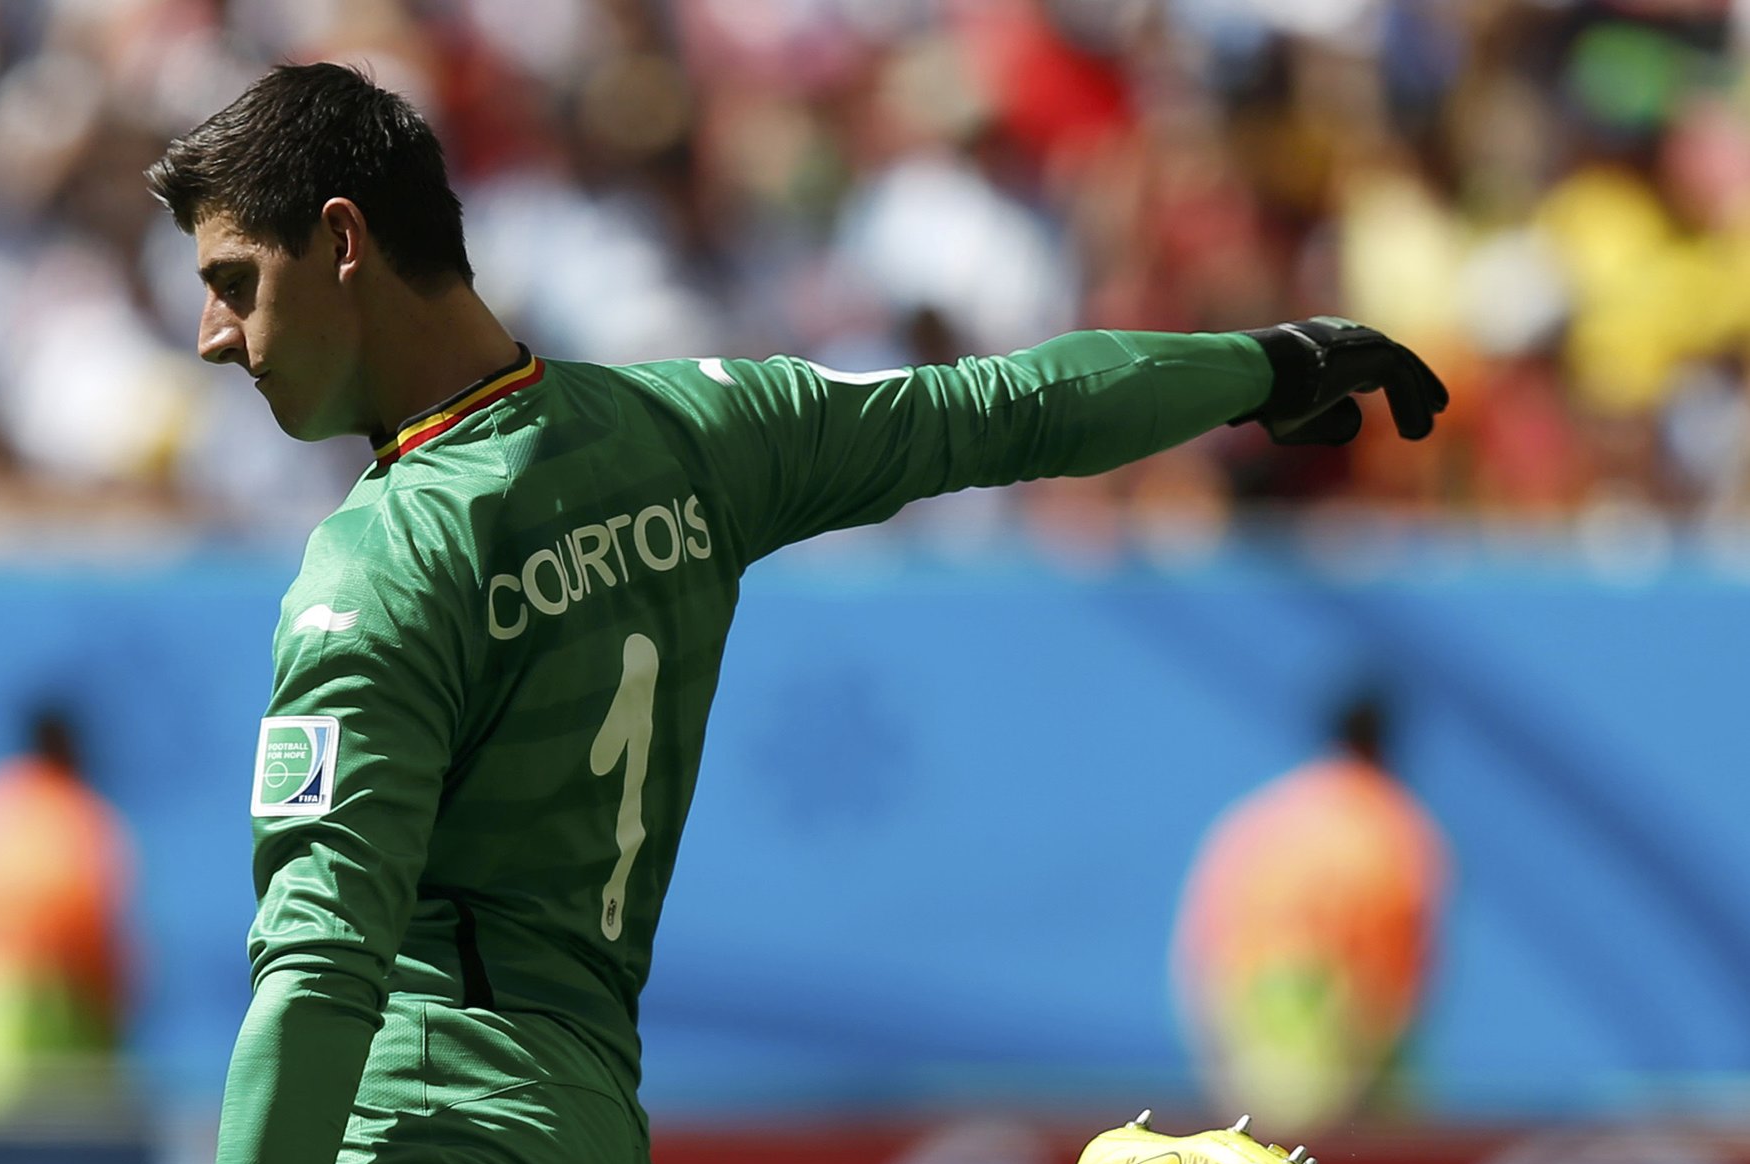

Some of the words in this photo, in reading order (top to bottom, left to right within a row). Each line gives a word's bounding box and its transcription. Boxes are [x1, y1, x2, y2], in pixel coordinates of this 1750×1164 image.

[488, 493, 712, 641] COURTOIS
[268, 742, 309, 751] FOOTBALL
[266, 751, 283, 760] FOR
[283, 751, 307, 760] HOPE
[590, 632, 660, 942] 1
[298, 794, 319, 803] FIFA
